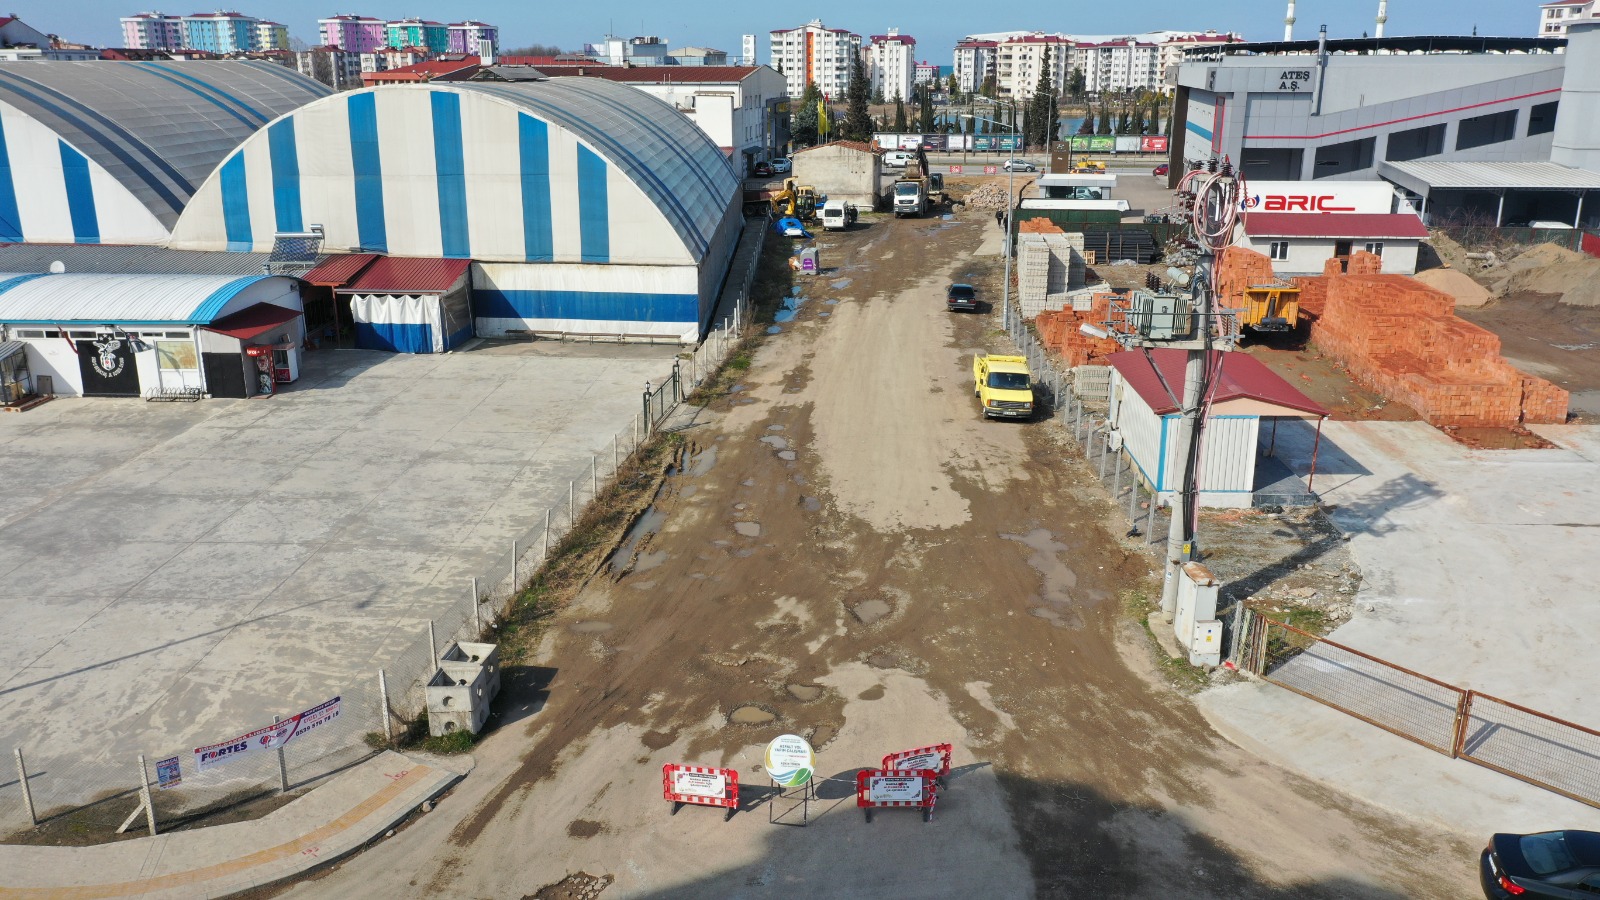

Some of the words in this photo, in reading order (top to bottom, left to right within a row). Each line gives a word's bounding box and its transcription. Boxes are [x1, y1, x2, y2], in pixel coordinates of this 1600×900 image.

[1280, 71, 1310, 81] ATEŞ
[1279, 81, 1300, 91] A.Ş.
[201, 741, 248, 762] FORTES
